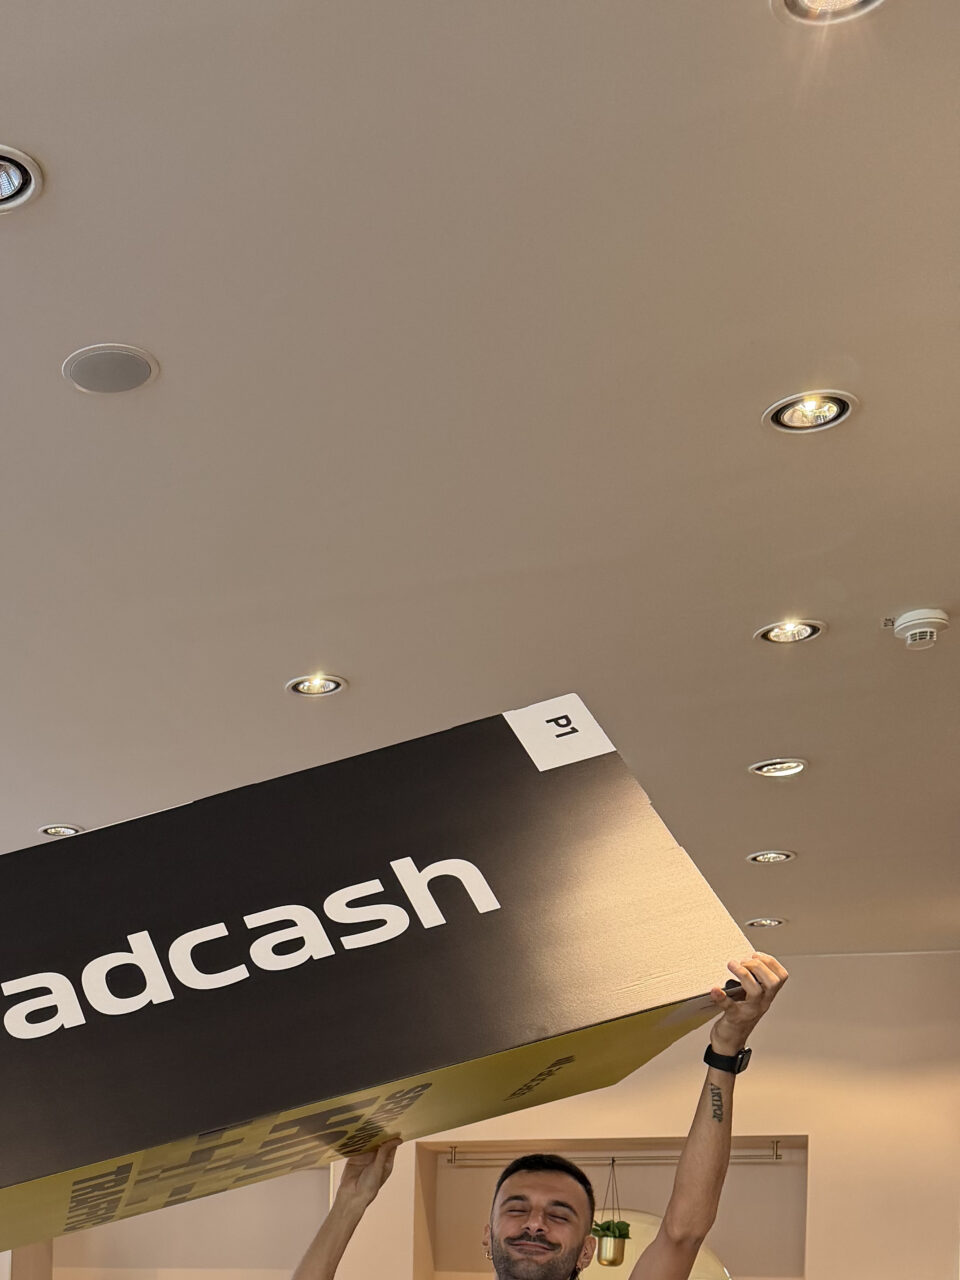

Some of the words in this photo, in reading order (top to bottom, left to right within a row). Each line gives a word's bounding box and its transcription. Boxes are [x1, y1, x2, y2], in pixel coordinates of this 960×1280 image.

[545, 713, 580, 739] P1
[0, 856, 501, 1040] adcash
[709, 1082, 724, 1123] ARTPOP
[63, 1161, 133, 1233] TRAFFIC
